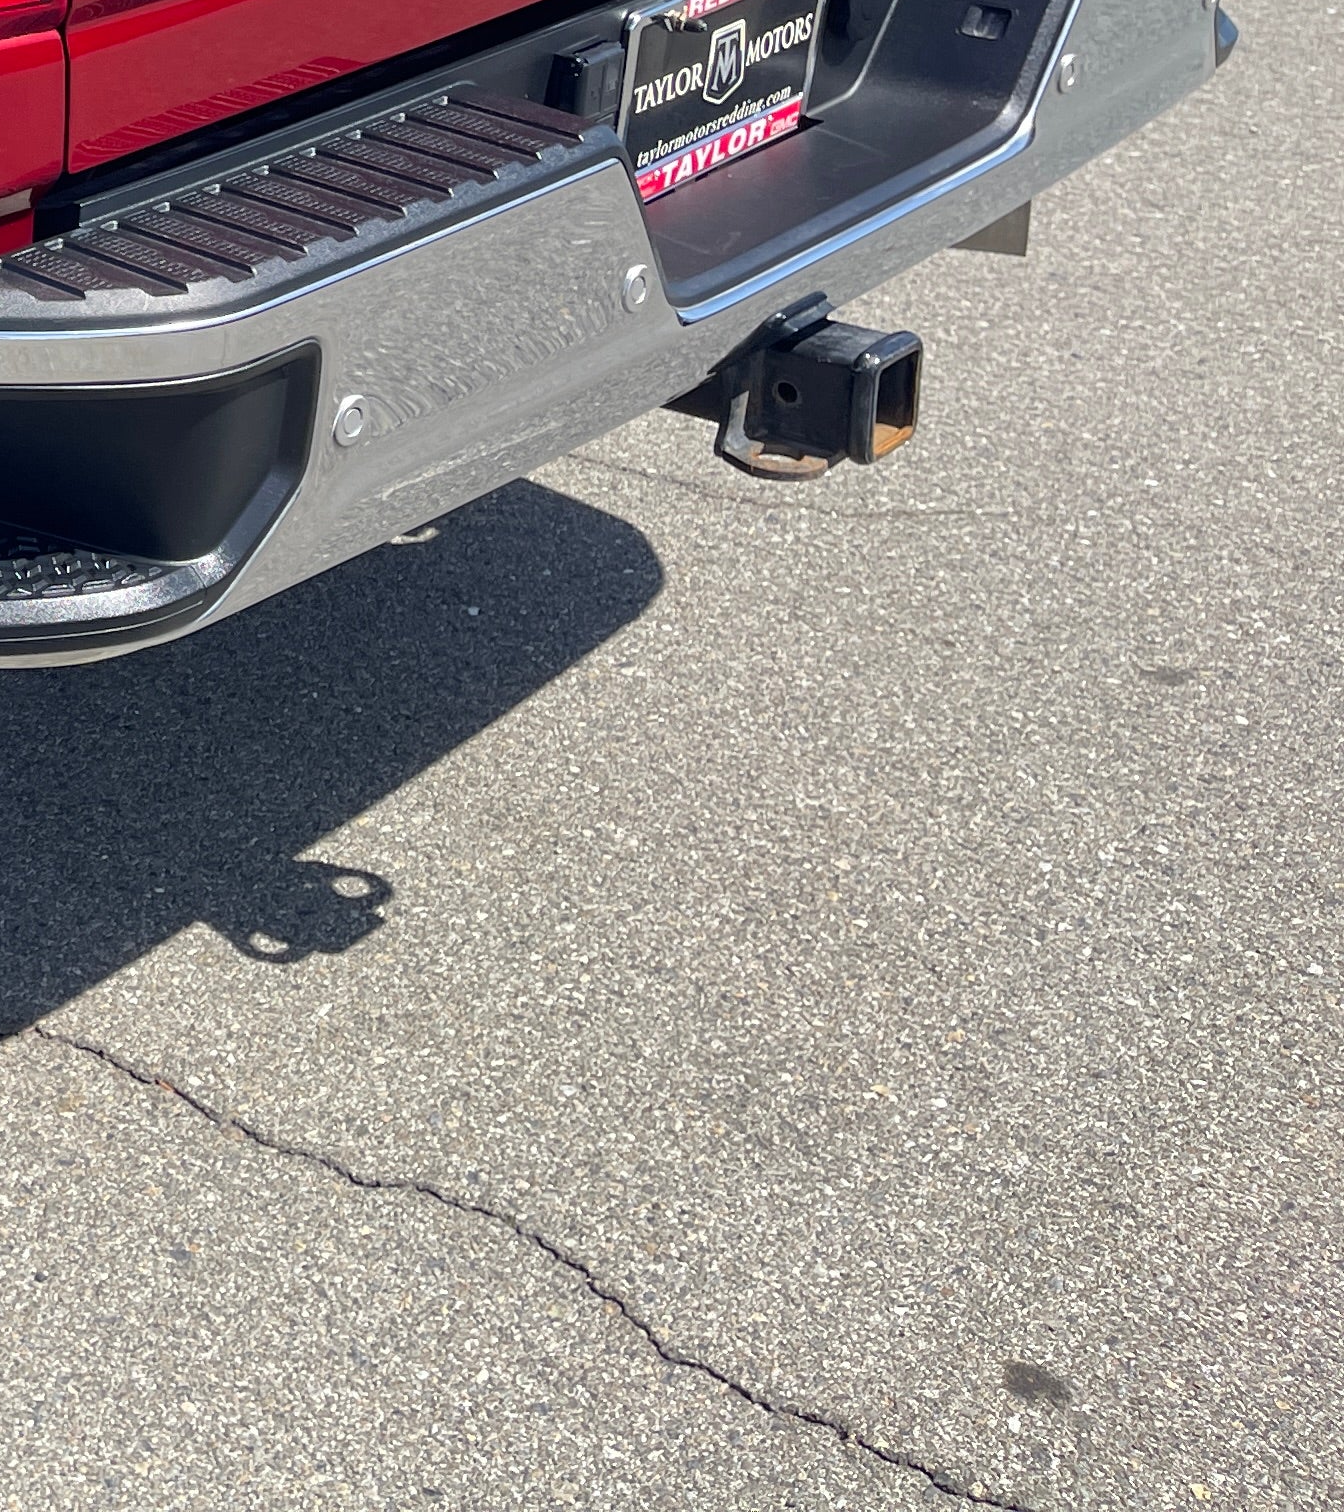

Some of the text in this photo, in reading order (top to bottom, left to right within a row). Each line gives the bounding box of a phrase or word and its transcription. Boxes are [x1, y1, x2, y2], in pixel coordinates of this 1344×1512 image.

[634, 62, 704, 114] TAYLOR
[745, 12, 814, 67] MOTORS
[637, 85, 792, 169] taylormotorsredding.com
[661, 117, 768, 189] TAYLOR
[769, 111, 799, 137] GMC
